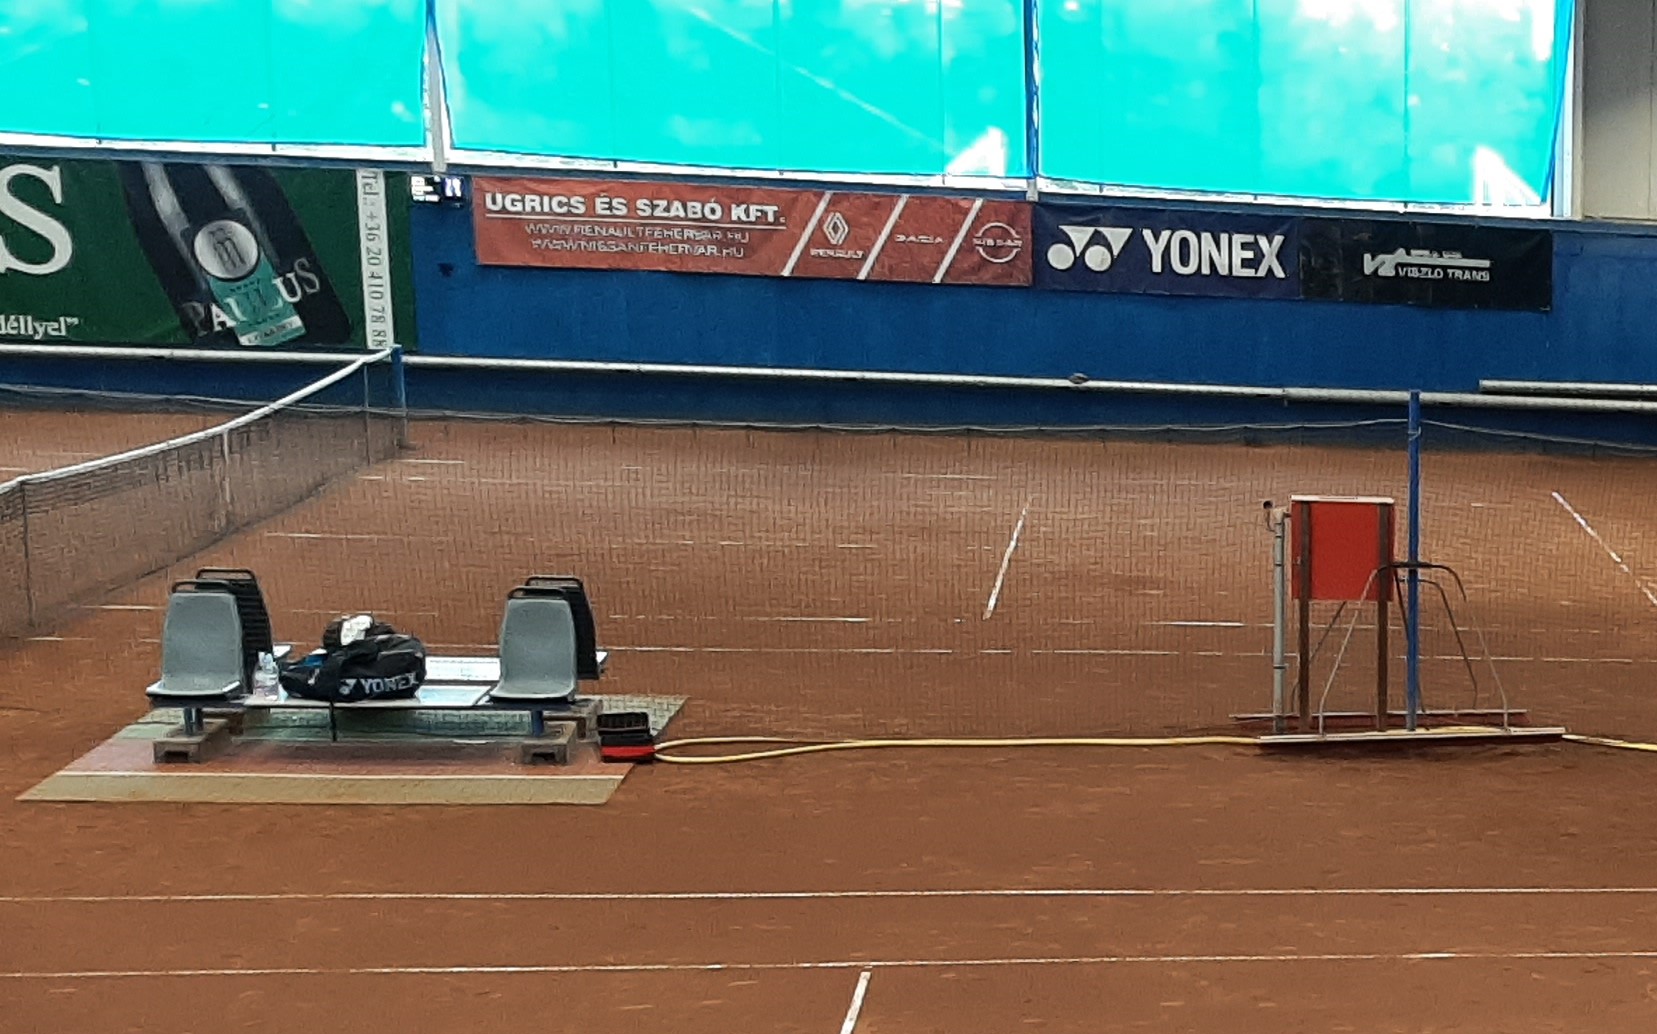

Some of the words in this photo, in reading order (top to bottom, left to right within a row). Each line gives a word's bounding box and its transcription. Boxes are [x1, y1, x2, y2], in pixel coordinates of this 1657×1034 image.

[0, 163, 72, 275] S
[484, 191, 587, 215] UGRICS
[594, 193, 629, 217] ÉS
[635, 197, 723, 221] SZABÓ
[730, 203, 786, 223] KFT.
[365, 211, 381, 242] +36
[366, 247, 382, 267] 20
[1141, 227, 1287, 279] YONEX
[1446, 267, 1490, 282] TRANS
[359, 671, 419, 695] YONEX
